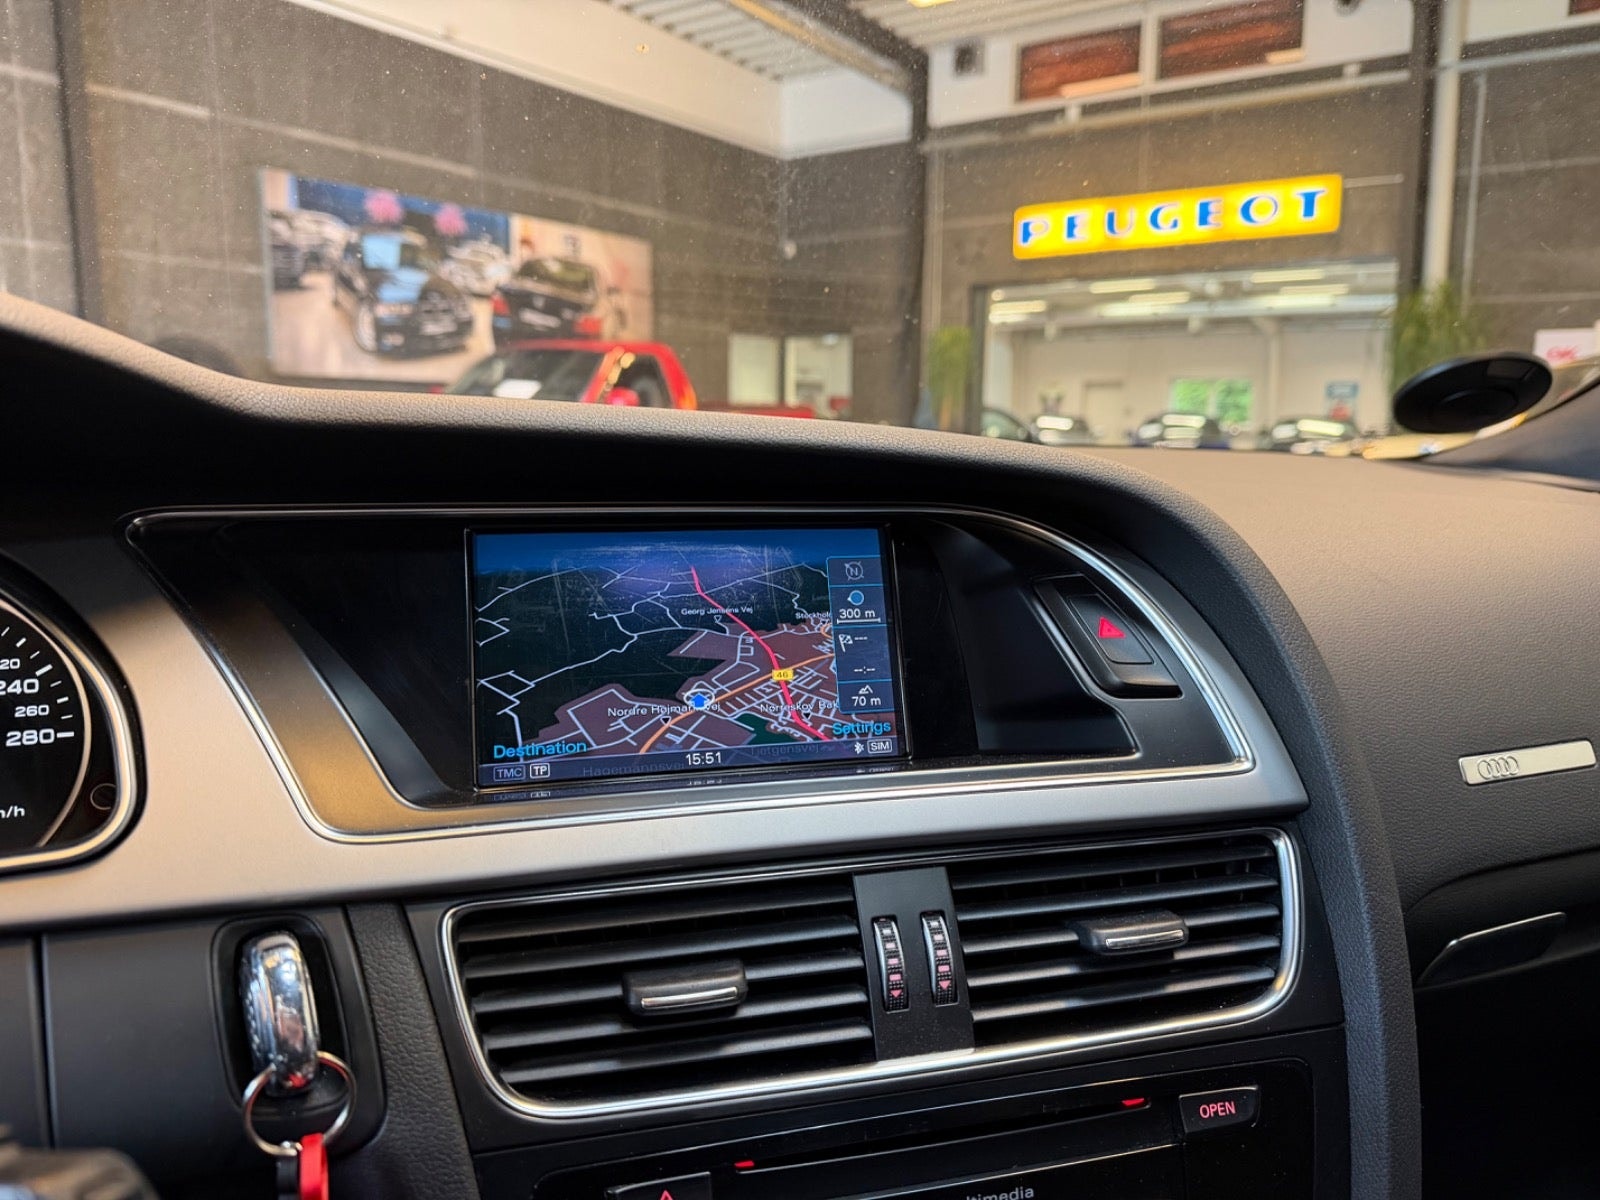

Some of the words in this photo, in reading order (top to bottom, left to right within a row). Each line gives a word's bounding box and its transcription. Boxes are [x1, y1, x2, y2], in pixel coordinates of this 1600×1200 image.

[1020, 189, 1327, 246] PEUGEOT
[681, 608, 705, 616] Georg
[741, 606, 753, 614] Vej
[839, 608, 861, 619] 300
[865, 609, 876, 618] m
[851, 696, 867, 706] 70
[870, 697, 881, 706] m
[14, 704, 49, 718] 260
[607, 706, 648, 717] Nordre
[832, 721, 891, 735] Settings
[6, 728, 55, 747] 280
[493, 740, 587, 759] Destination
[685, 751, 722, 766] 15:51
[497, 767, 522, 779] TMC
[532, 765, 547, 776] TP
[1200, 1101, 1236, 1119] OPEN
